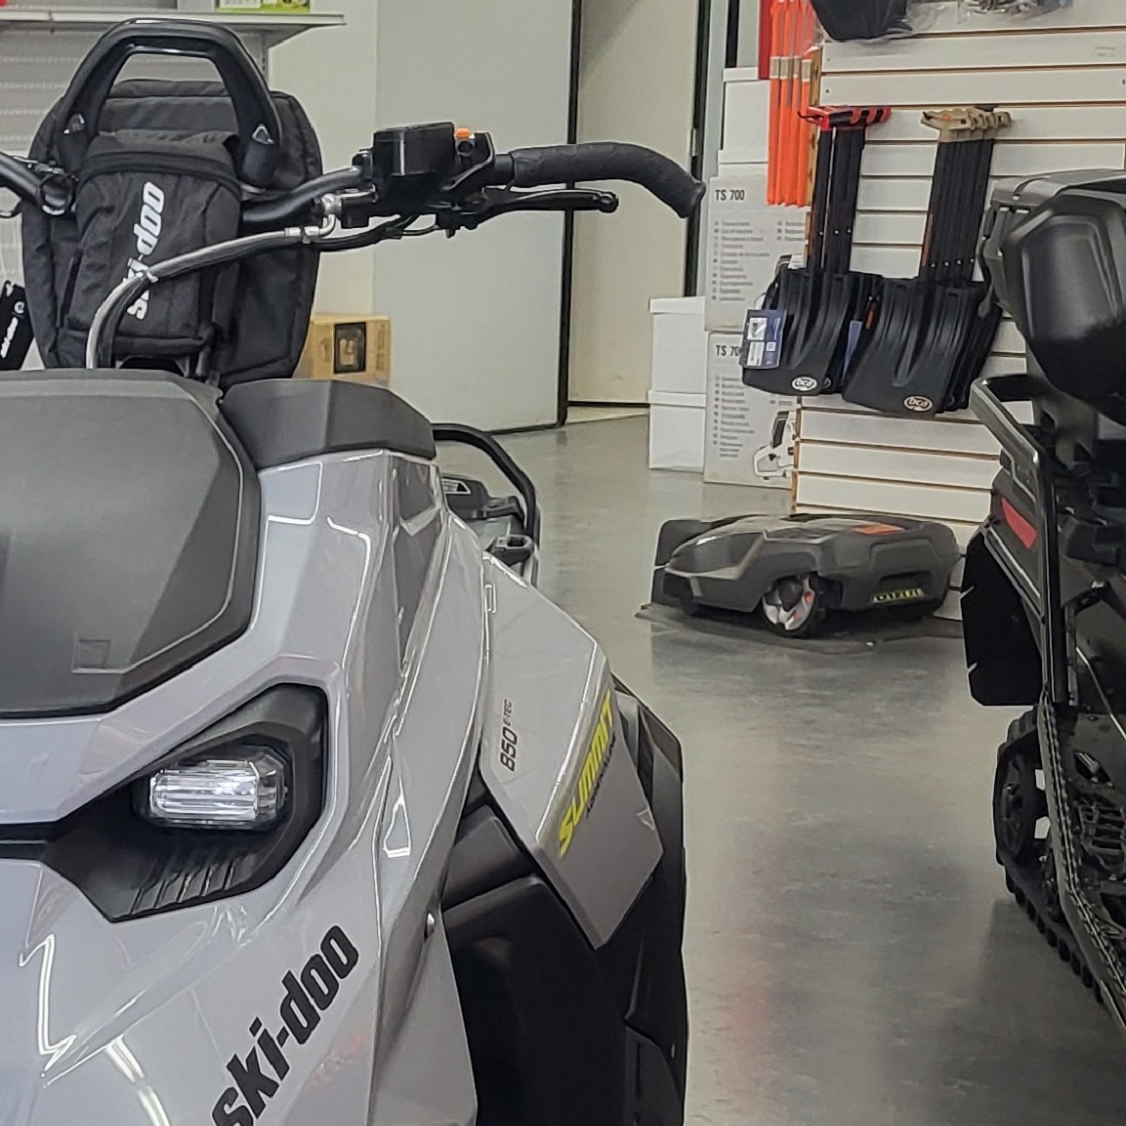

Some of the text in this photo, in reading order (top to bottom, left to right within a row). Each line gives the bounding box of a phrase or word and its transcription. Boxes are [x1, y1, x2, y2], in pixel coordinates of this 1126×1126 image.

[715, 189, 745, 201] TS 700
[716, 344, 727, 357] TS
[500, 699, 518, 772] 850 E-TEC
